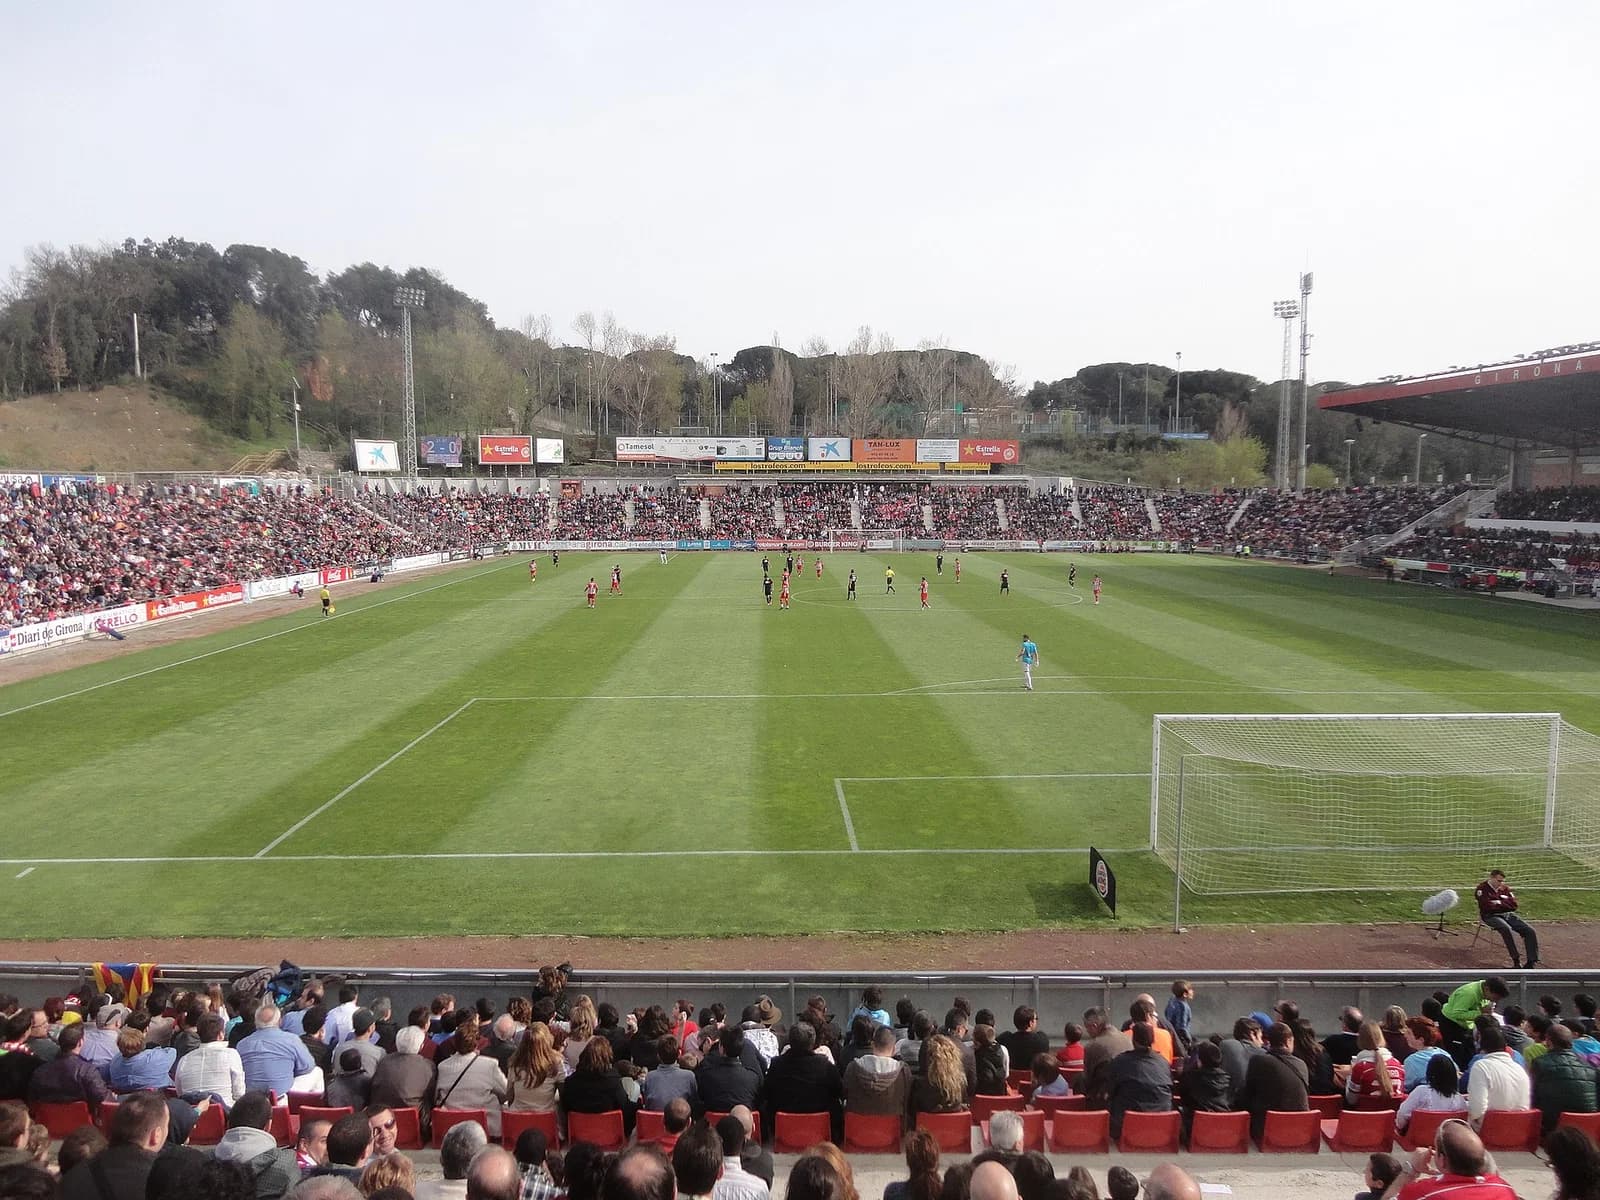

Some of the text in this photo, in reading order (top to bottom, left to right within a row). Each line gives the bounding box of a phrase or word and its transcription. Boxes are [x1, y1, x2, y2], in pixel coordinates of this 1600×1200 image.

[1474, 359, 1583, 385] GIRONA
[427, 441, 434, 453] 2
[449, 441, 456, 453] 0
[975, 445, 1001, 453] Estrella
[17, 622, 83, 646] Diari de Girona
